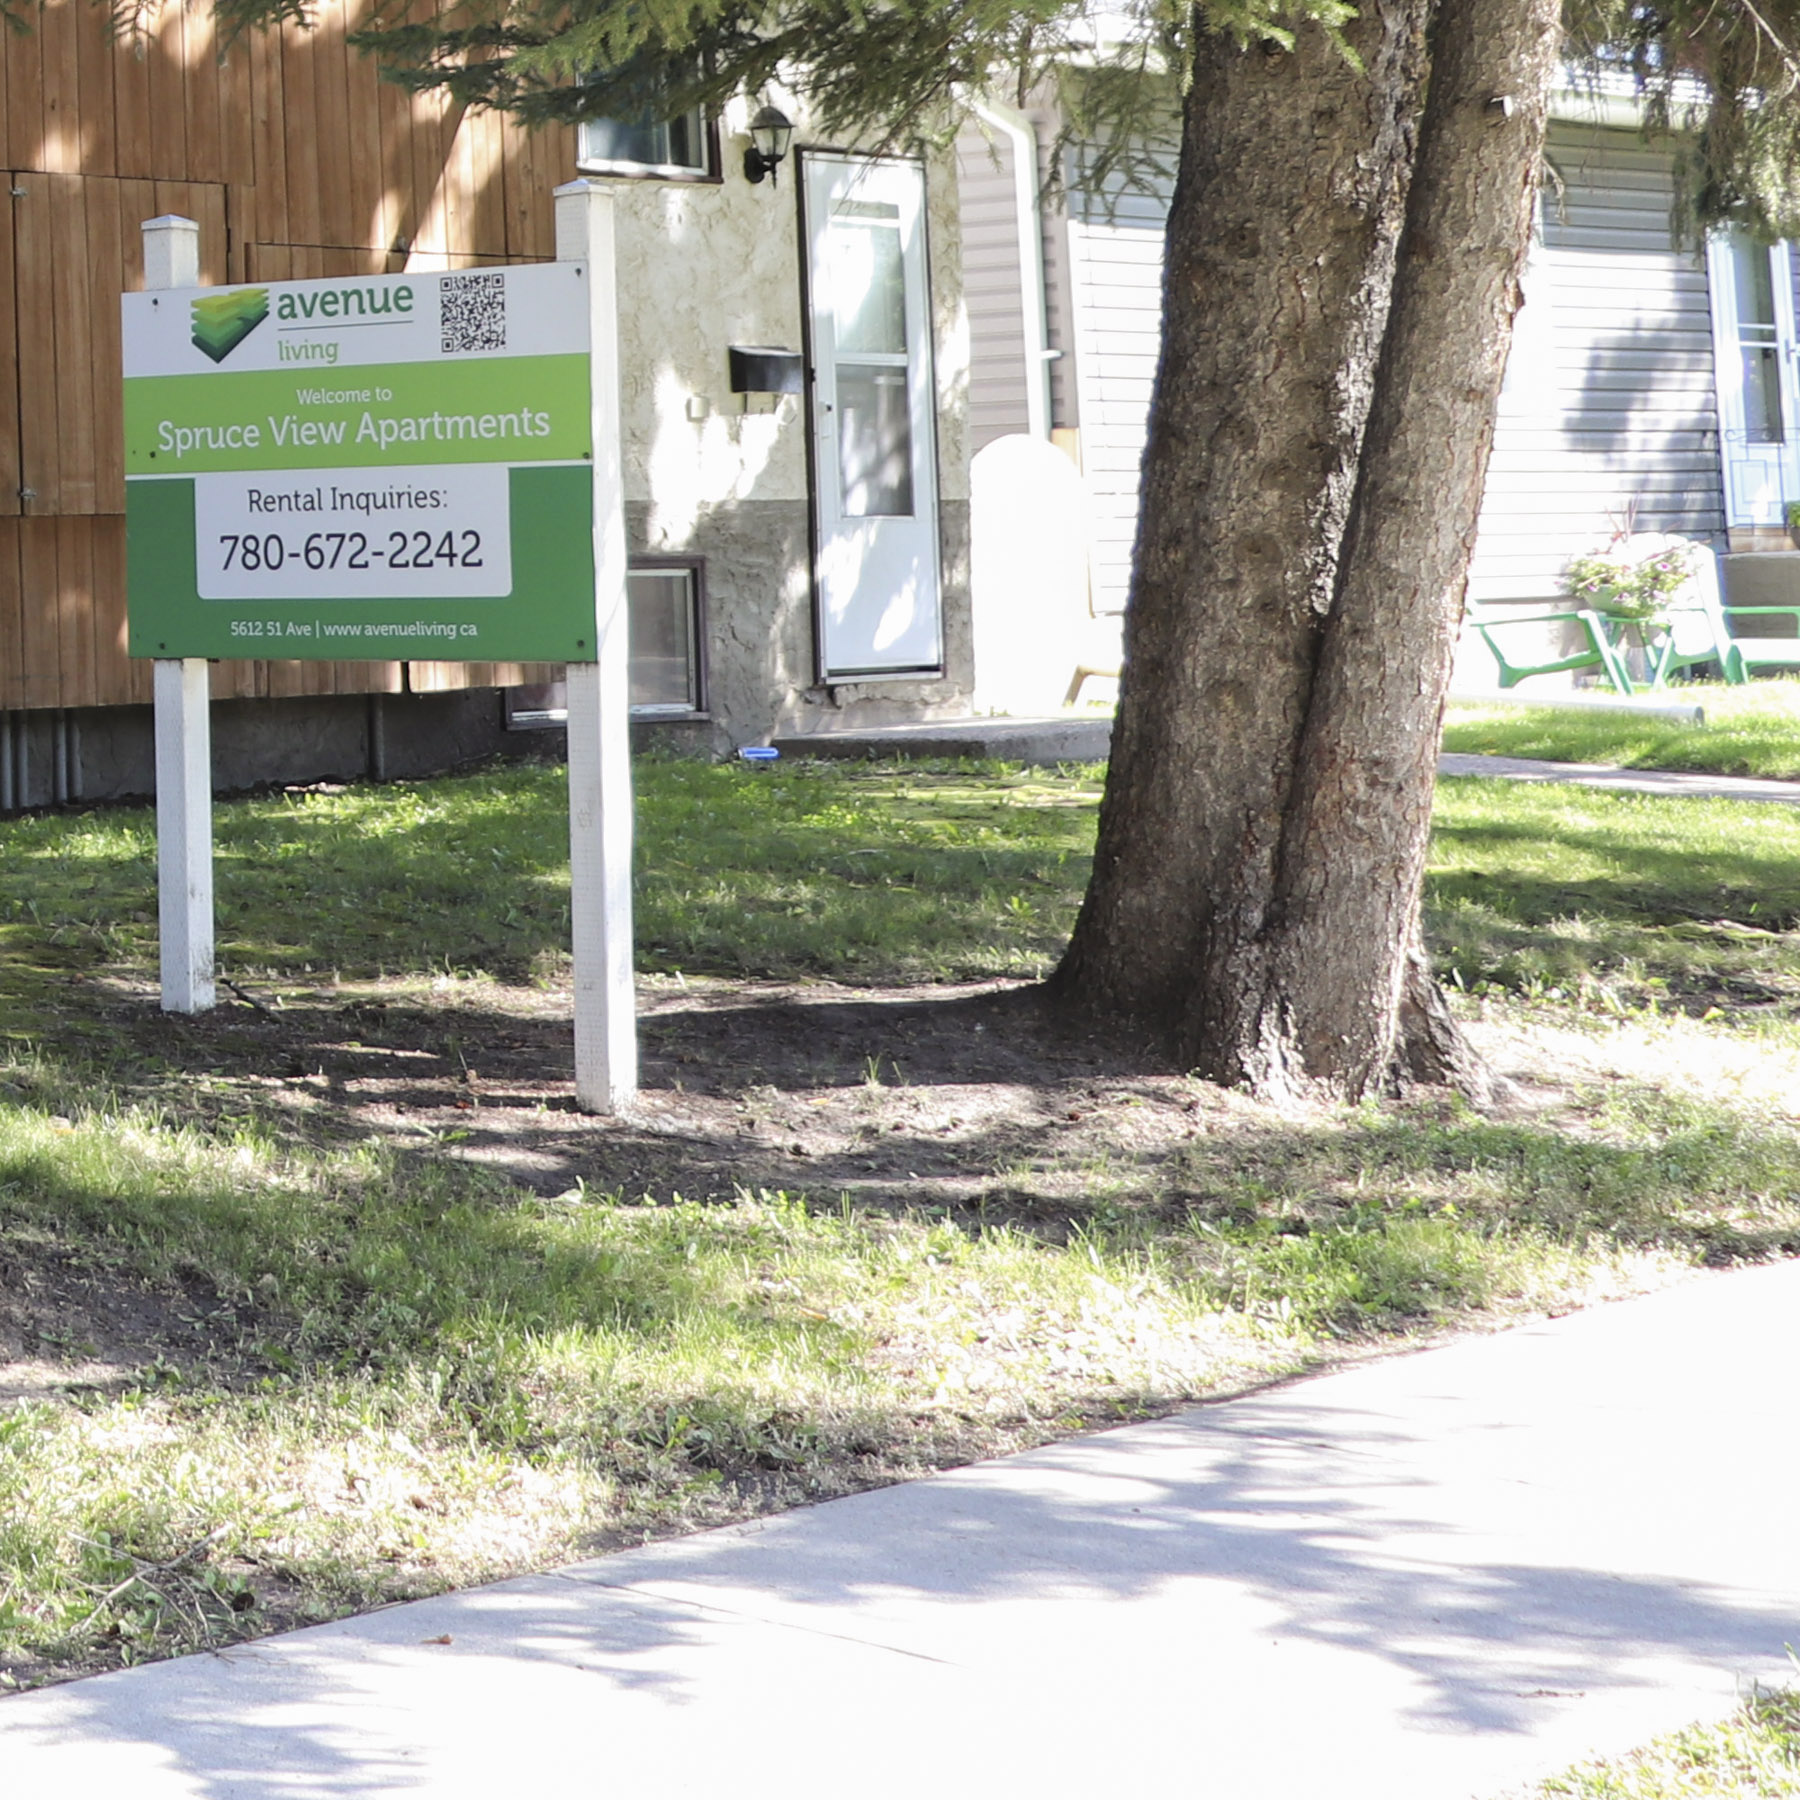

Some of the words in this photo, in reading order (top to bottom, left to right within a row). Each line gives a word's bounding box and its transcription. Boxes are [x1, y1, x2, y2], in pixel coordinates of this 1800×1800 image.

[277, 285, 414, 320] avenue
[278, 340, 339, 364] living
[296, 388, 371, 405] Welcome
[375, 387, 392, 402] to
[157, 420, 260, 458] Spruce
[268, 415, 346, 446] View
[355, 407, 551, 450] Apartments
[247, 487, 323, 513] Rental
[330, 484, 448, 516] Inquiries:
[219, 529, 483, 571] 780-672-2242
[230, 621, 263, 636] 5612
[266, 621, 282, 636] 51
[286, 621, 312, 636] Ave
